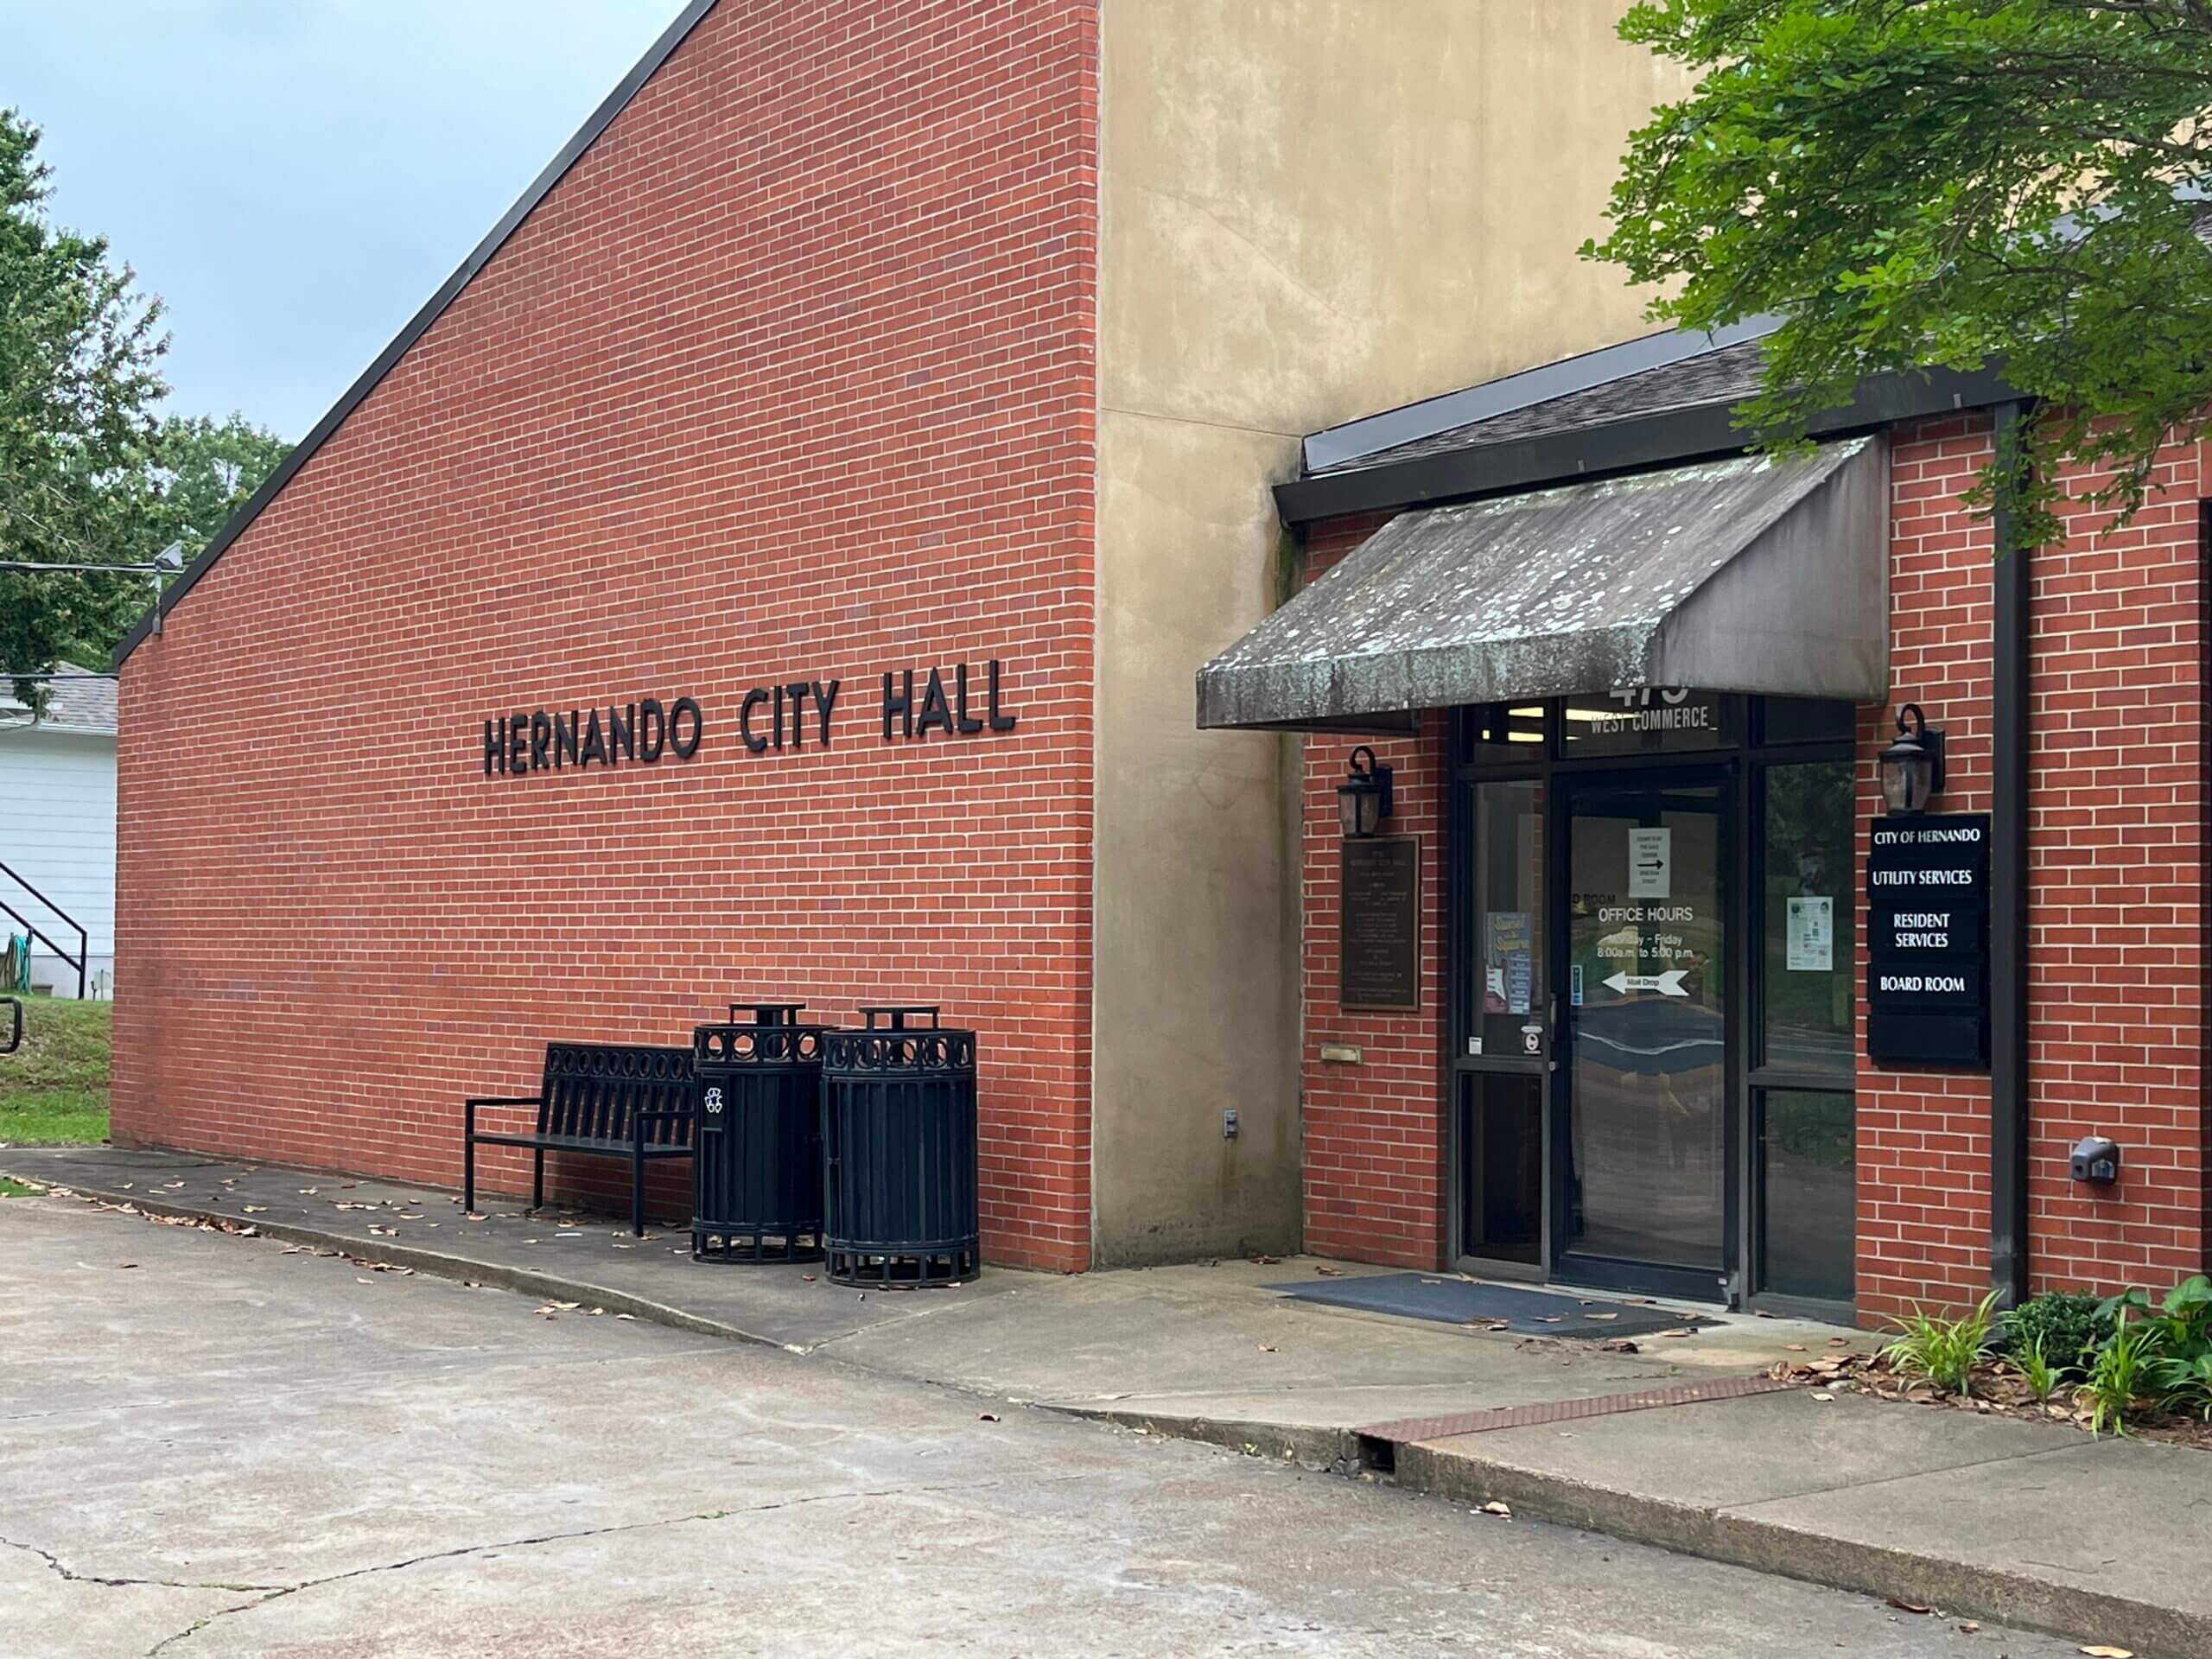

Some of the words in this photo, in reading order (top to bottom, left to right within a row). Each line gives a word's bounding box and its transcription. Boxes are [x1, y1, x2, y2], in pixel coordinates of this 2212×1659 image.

[484, 696, 702, 776] HERNANDO
[740, 678, 840, 753] CITY
[882, 658, 1017, 741] HALL
[1591, 712, 1625, 734] WEST
[1631, 705, 1709, 732] COMMERCE
[1874, 831, 1897, 844] CITY
[1900, 830, 1916, 843] OF
[1917, 828, 1980, 842] HERNANDO
[1872, 871, 1917, 885] UTILITY
[1919, 870, 1972, 884] SERVICES
[1599, 907, 1643, 922] OFFICE
[1647, 906, 1694, 921] HOURS
[1893, 913, 1949, 928] RESIDENT
[1655, 933, 1682, 947] Friday
[1895, 932, 1948, 948] SERVICES
[1639, 947, 1649, 958] to
[1651, 947, 1673, 959] 5:00
[1643, 978, 1660, 988] Drop
[1880, 976, 1922, 991] BOARD
[1924, 976, 1965, 991] ROOM
